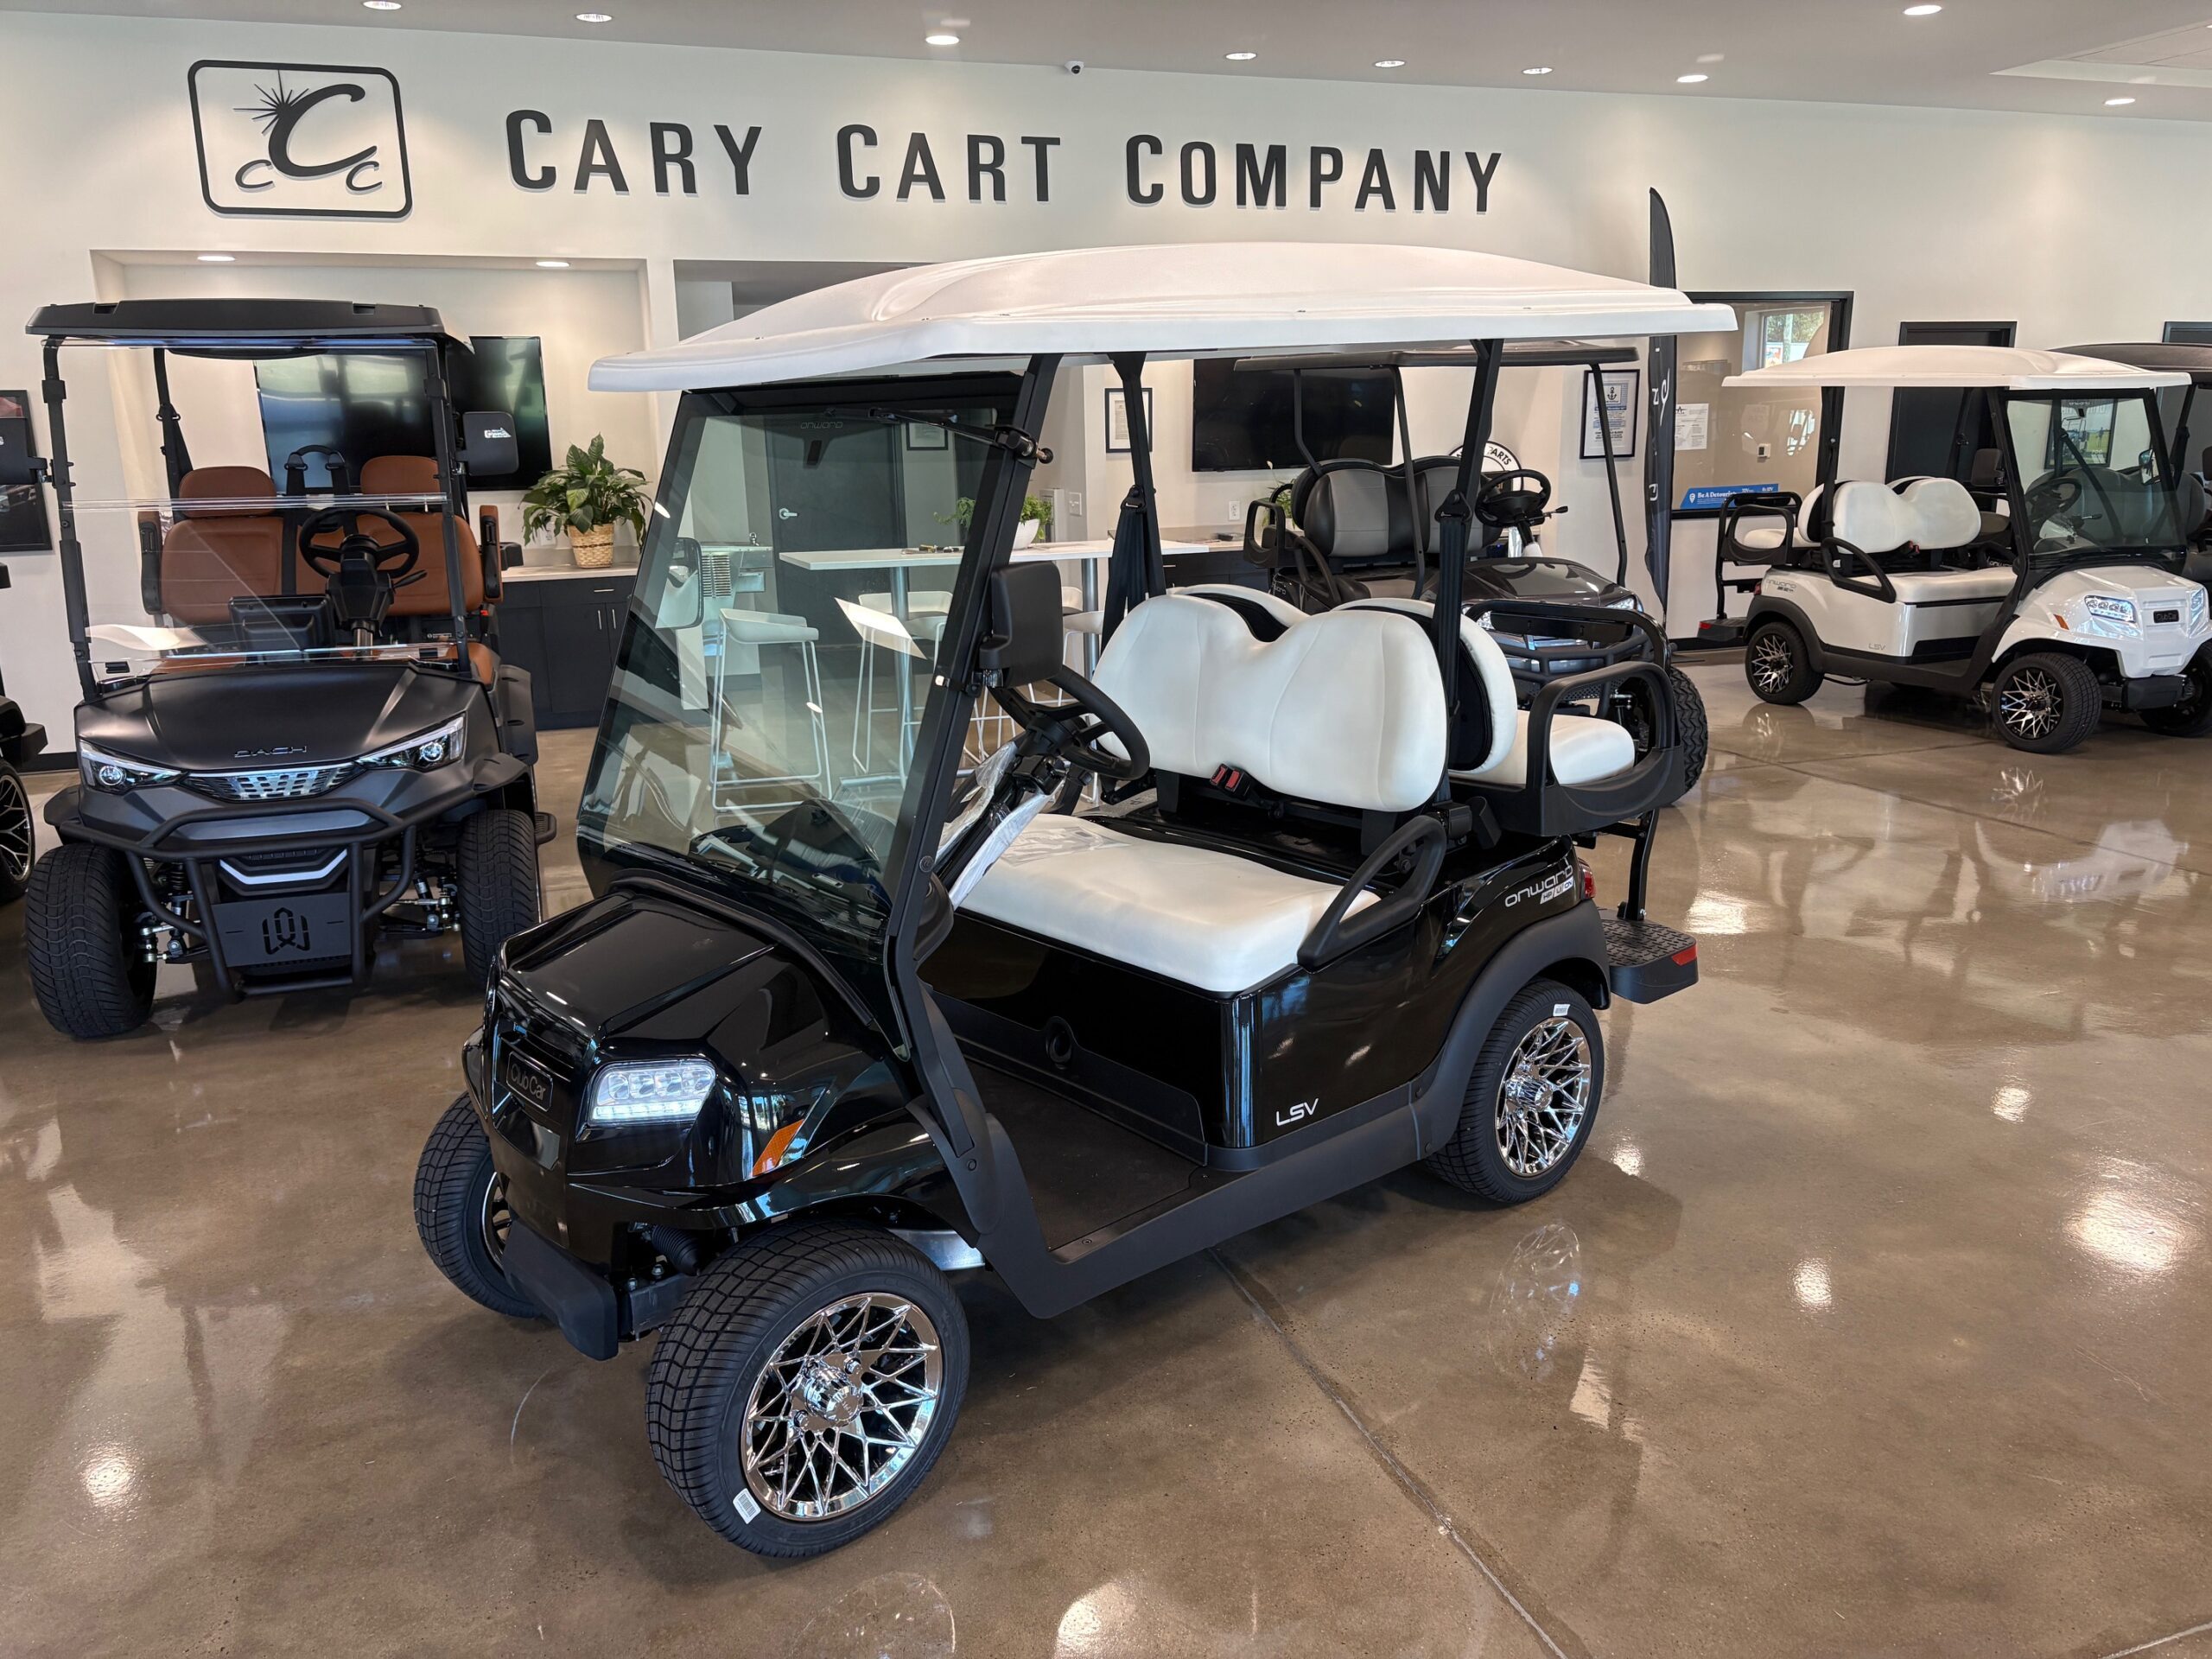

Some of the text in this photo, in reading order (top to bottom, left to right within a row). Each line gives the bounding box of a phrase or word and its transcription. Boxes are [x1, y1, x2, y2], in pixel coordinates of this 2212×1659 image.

[505, 109, 1502, 213] CARY CART COMPANY
[1275, 1097, 1319, 1127] LSV
